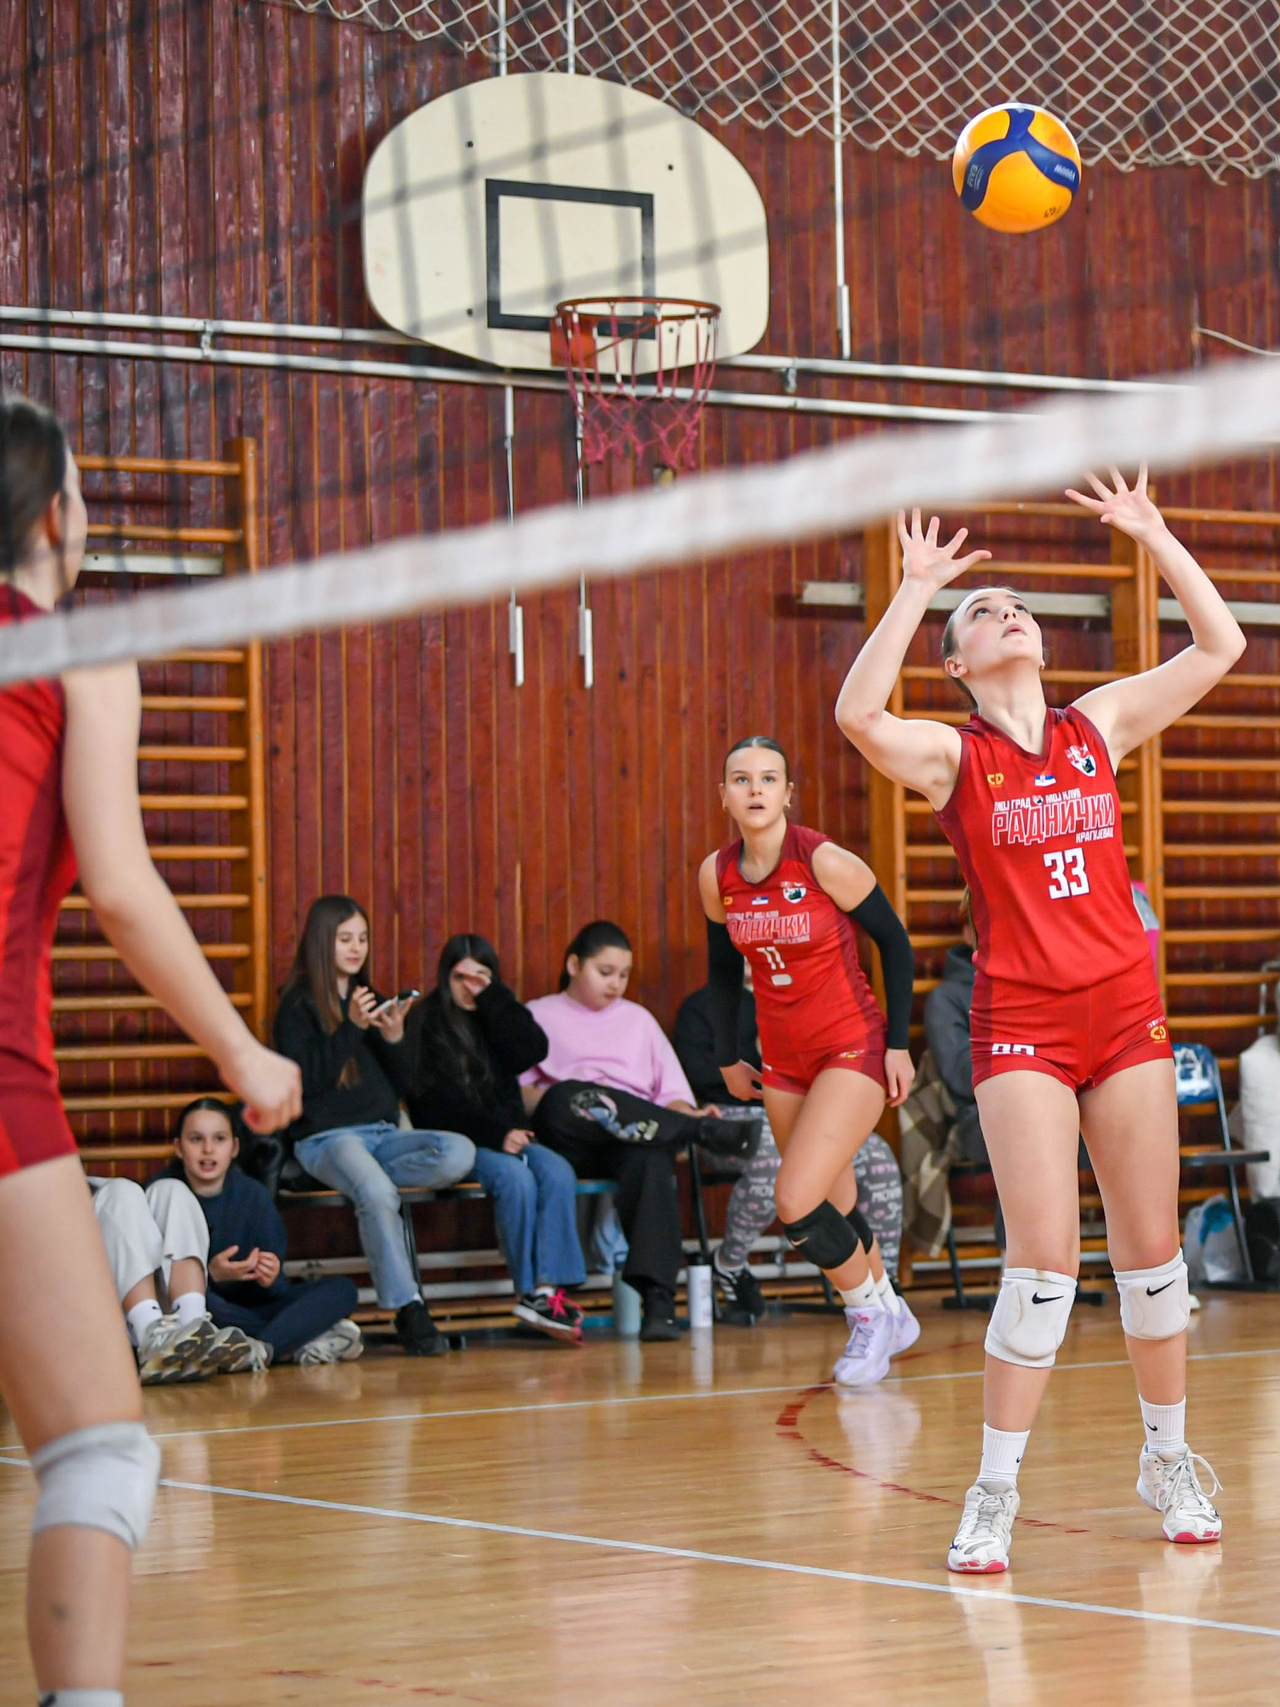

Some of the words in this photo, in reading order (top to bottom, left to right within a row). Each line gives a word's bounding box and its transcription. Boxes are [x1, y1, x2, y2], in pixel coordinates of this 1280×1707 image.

[992, 792, 1115, 846] РАДНИЧКИ
[1043, 847, 1090, 900] 33
[756, 946, 785, 970] 11
